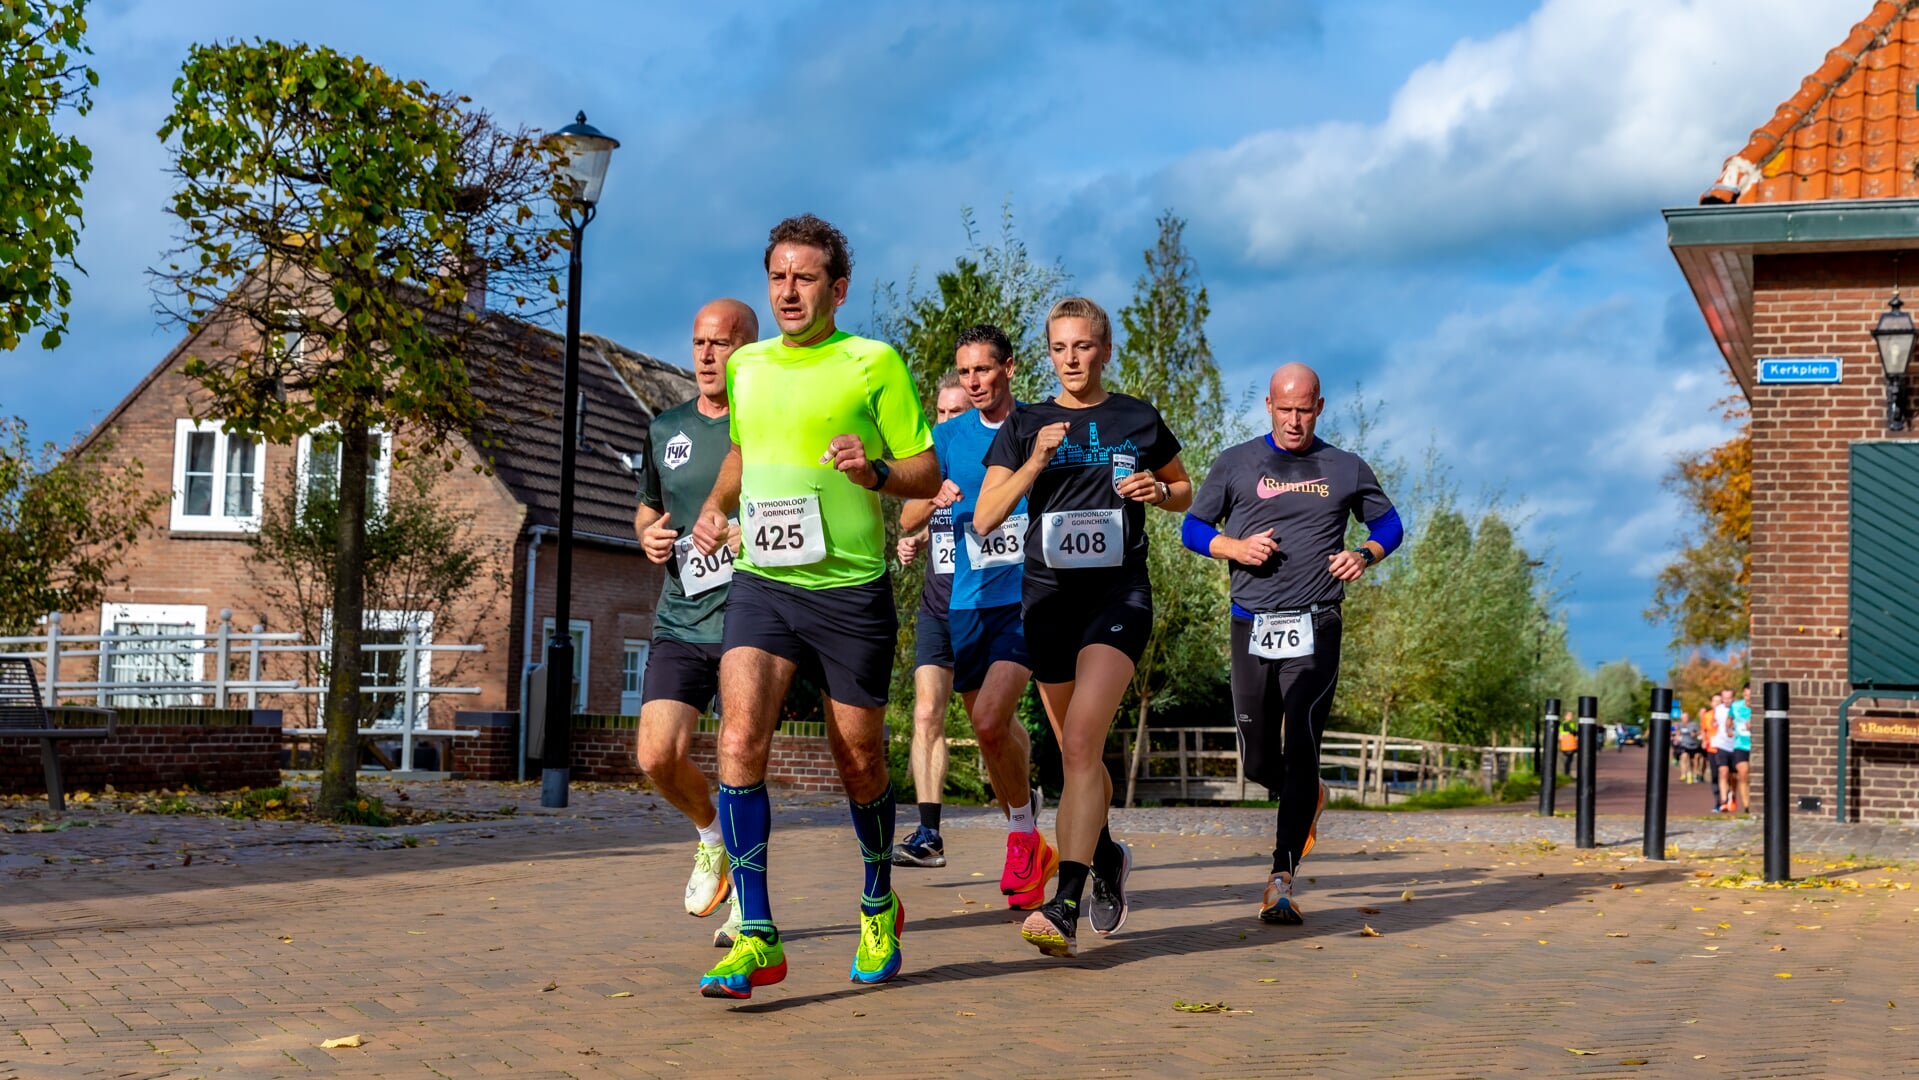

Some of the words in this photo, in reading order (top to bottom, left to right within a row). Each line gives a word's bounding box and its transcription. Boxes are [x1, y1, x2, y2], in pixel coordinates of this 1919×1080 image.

[1770, 364, 1830, 376] Kerkplein
[667, 445, 690, 459] 14K
[1264, 478, 1330, 497] Running
[756, 497, 808, 508] TYPHOONLOOP
[762, 507, 805, 518] GORINCHEM
[1067, 511, 1113, 519] TYPHOONLOOP
[755, 524, 804, 551] 425
[981, 535, 1019, 556] 463
[1059, 532, 1106, 554] 408
[690, 545, 734, 578] 304
[1261, 629, 1300, 650] 476
